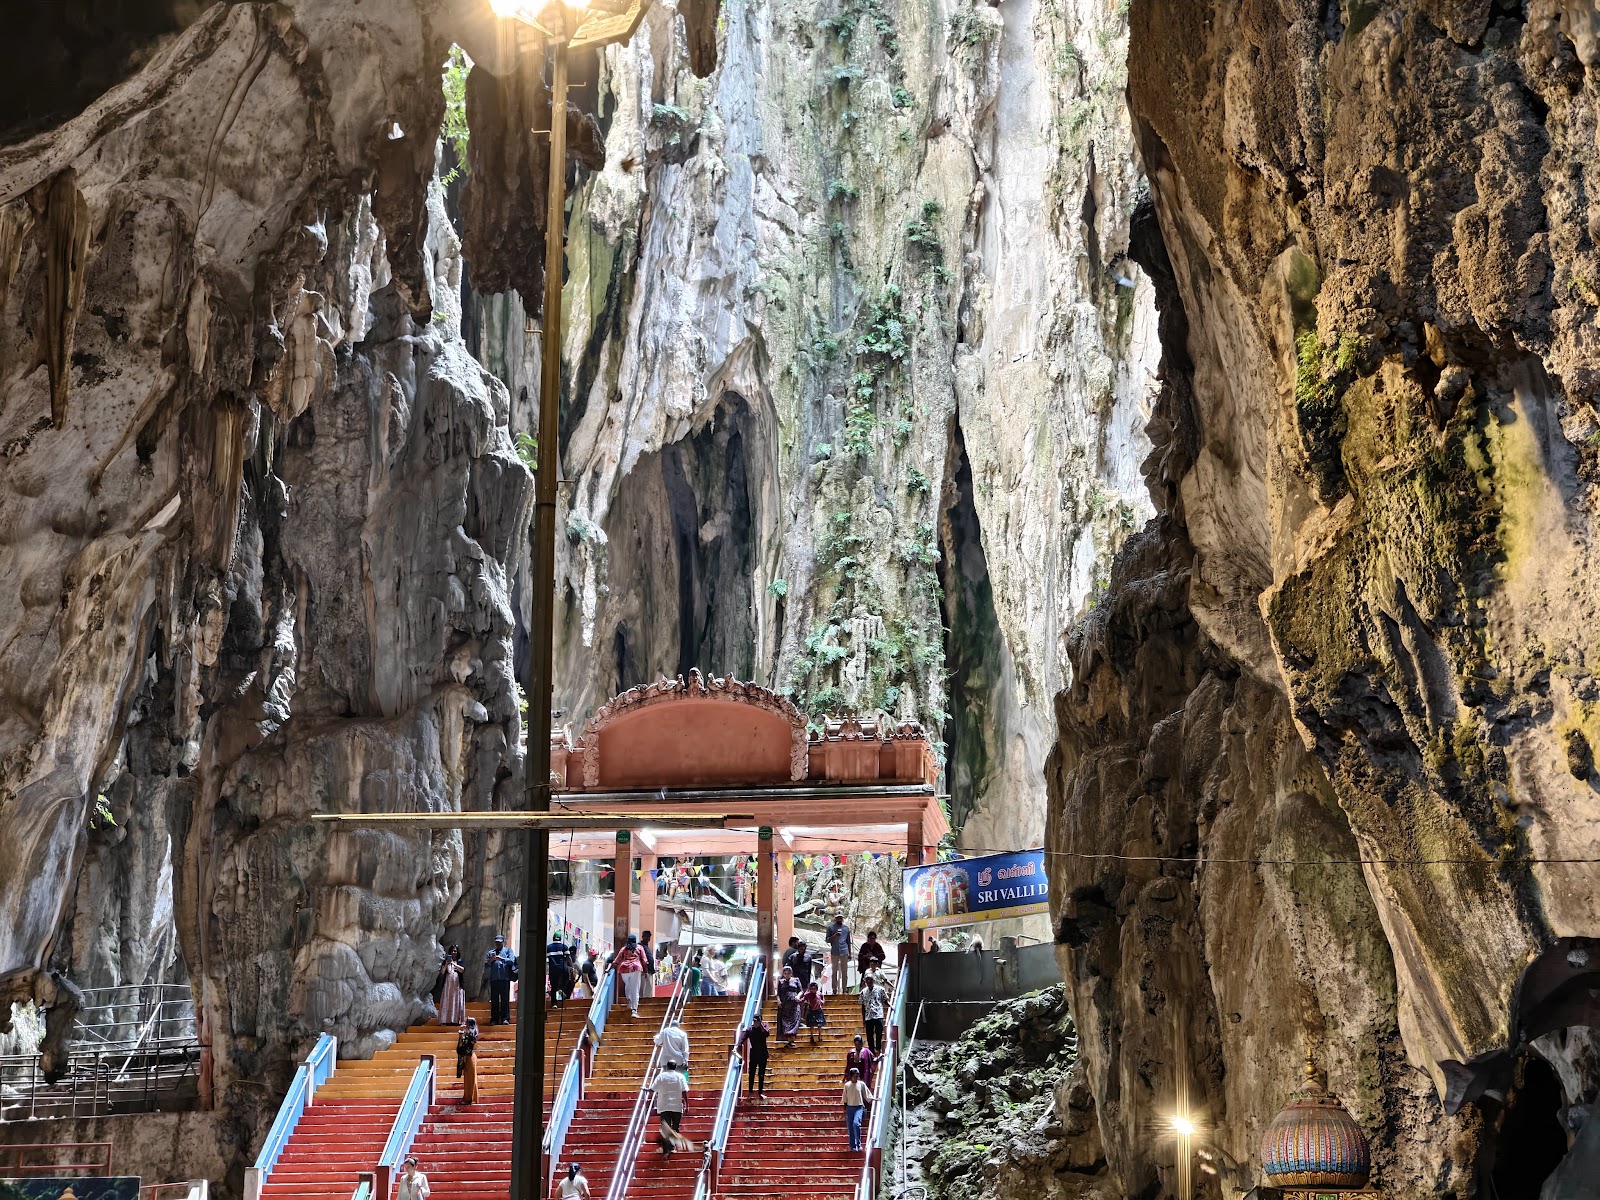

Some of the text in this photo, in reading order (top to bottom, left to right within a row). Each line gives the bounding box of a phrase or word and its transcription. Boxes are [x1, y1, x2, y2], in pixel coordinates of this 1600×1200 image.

[997, 861, 1036, 880] வள்ளி
[978, 889, 998, 903] SRI
[1000, 884, 1035, 900] VALLI
